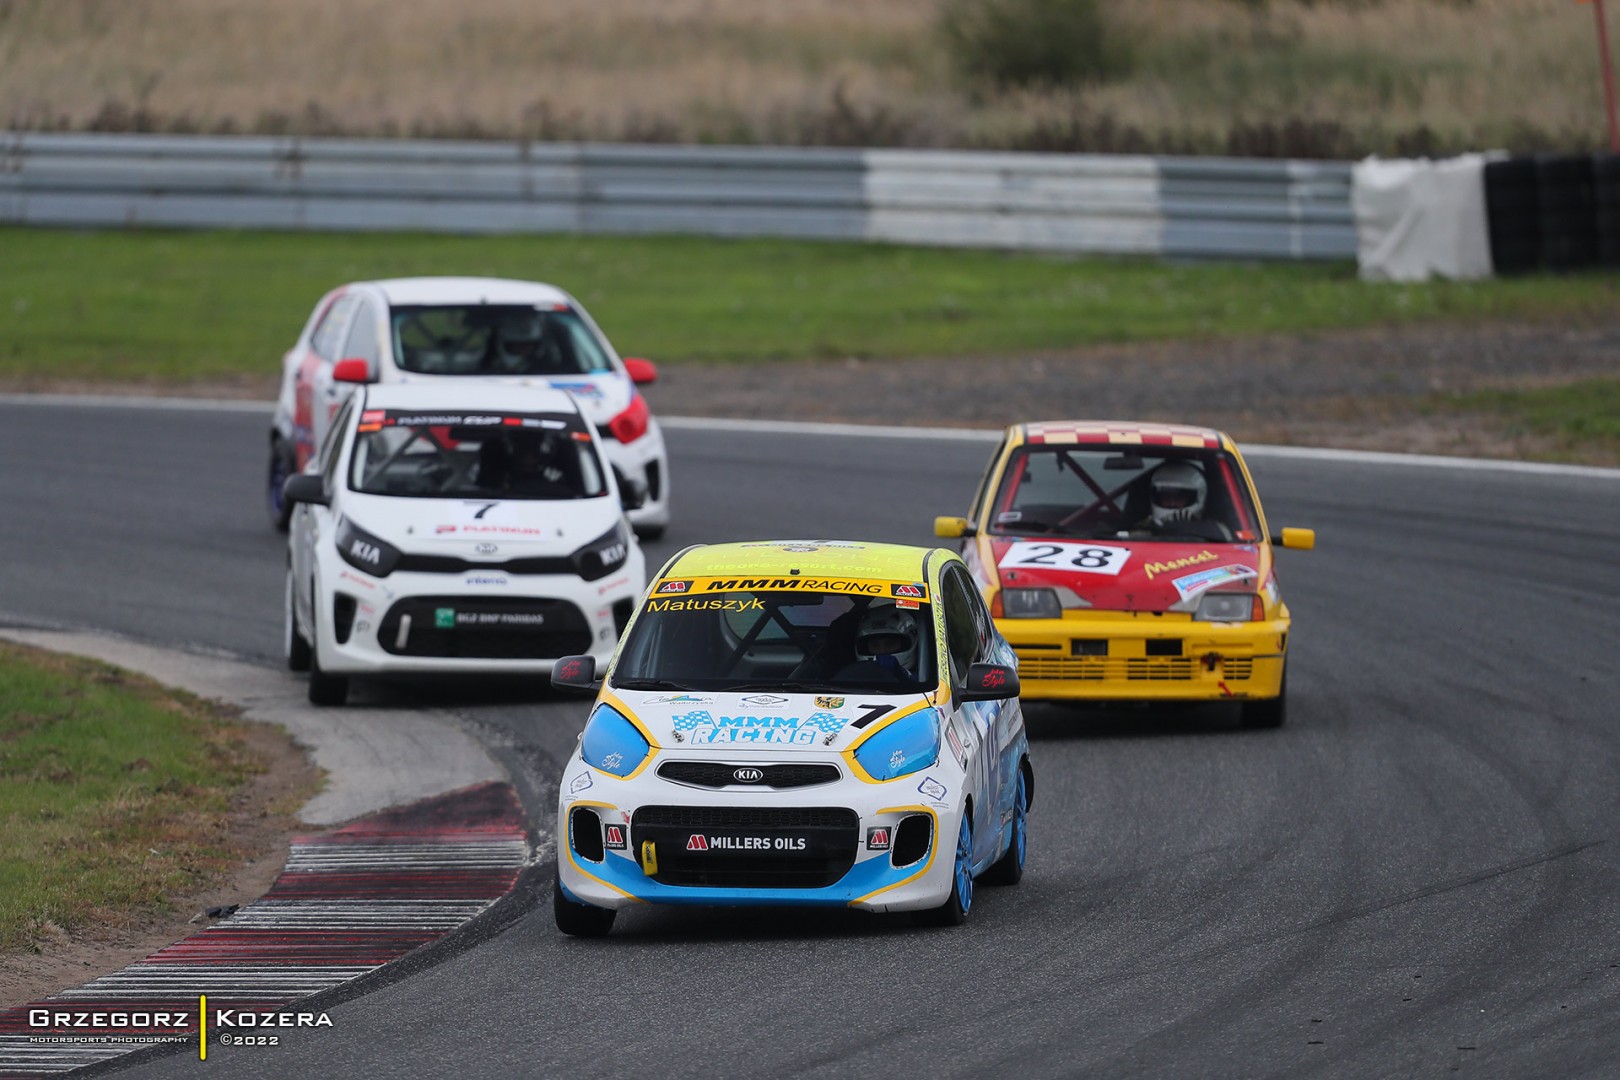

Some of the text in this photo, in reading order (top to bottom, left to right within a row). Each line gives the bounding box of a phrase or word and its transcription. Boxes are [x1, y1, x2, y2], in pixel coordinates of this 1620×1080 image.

[463, 500, 500, 519] 7
[350, 539, 380, 565] KIA
[600, 543, 627, 566] KIA
[1017, 544, 1114, 569] 28
[647, 597, 766, 613] Matuszyk
[718, 716, 800, 729] MMM
[691, 727, 818, 745] RACING
[738, 770, 758, 779] KIA
[710, 836, 806, 851] MILLERS OILS
